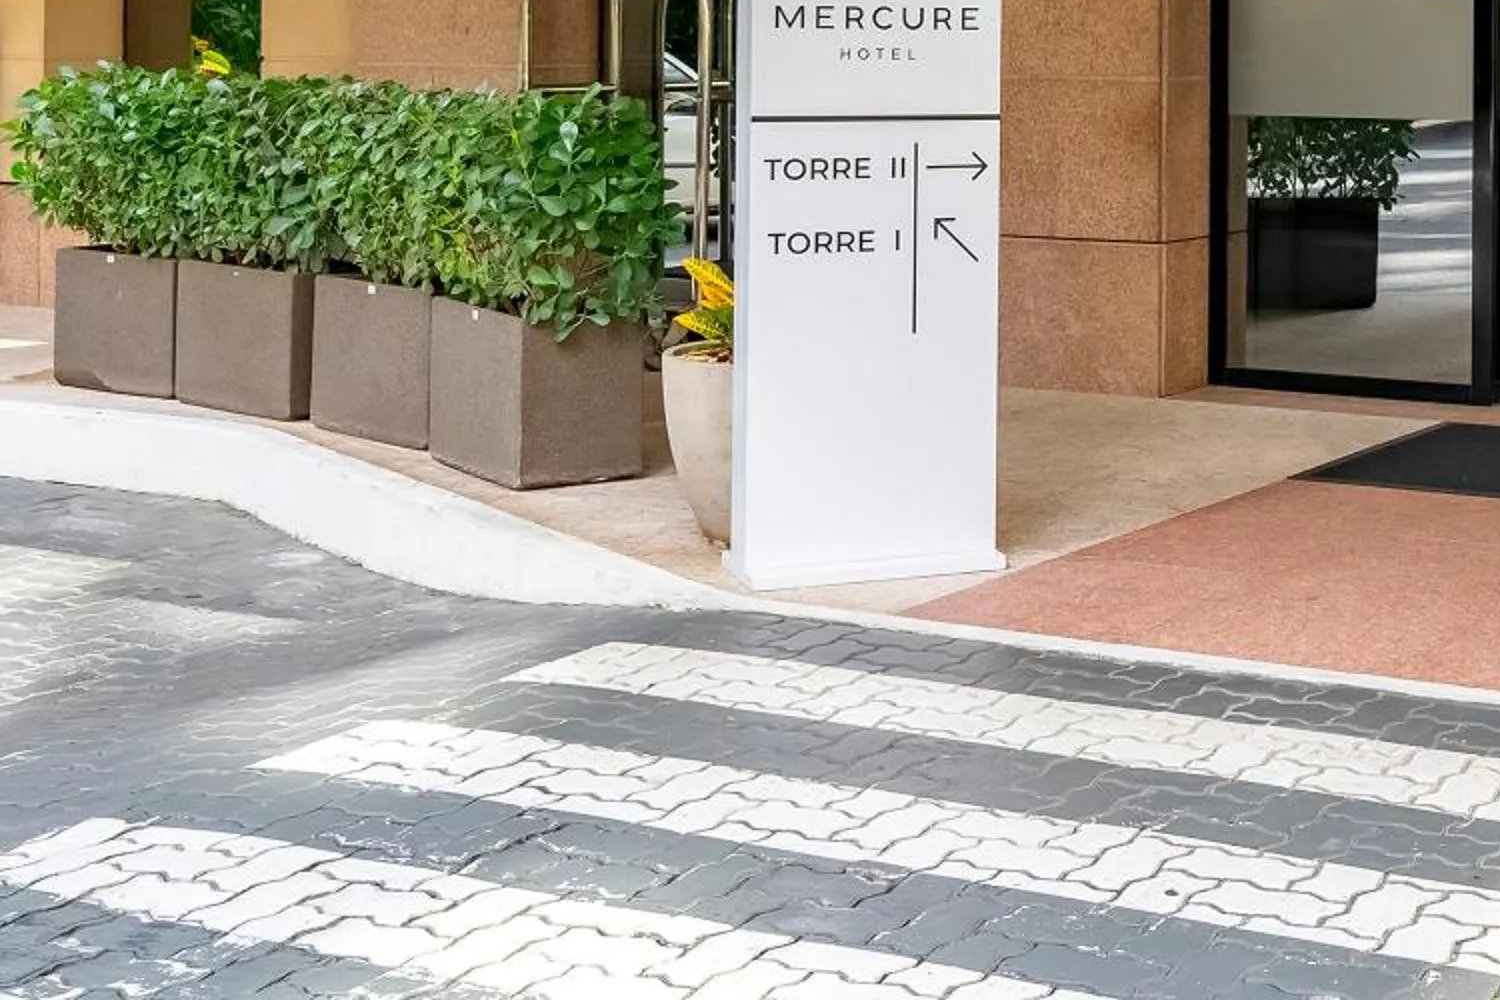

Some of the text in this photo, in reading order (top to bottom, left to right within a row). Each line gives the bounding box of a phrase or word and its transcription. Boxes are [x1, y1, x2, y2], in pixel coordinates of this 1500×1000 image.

[774, 5, 980, 31] MERCURE
[839, 47, 917, 61] HOTEL
[764, 157, 906, 181] TORRE II
[767, 229, 901, 255] TORRE I
